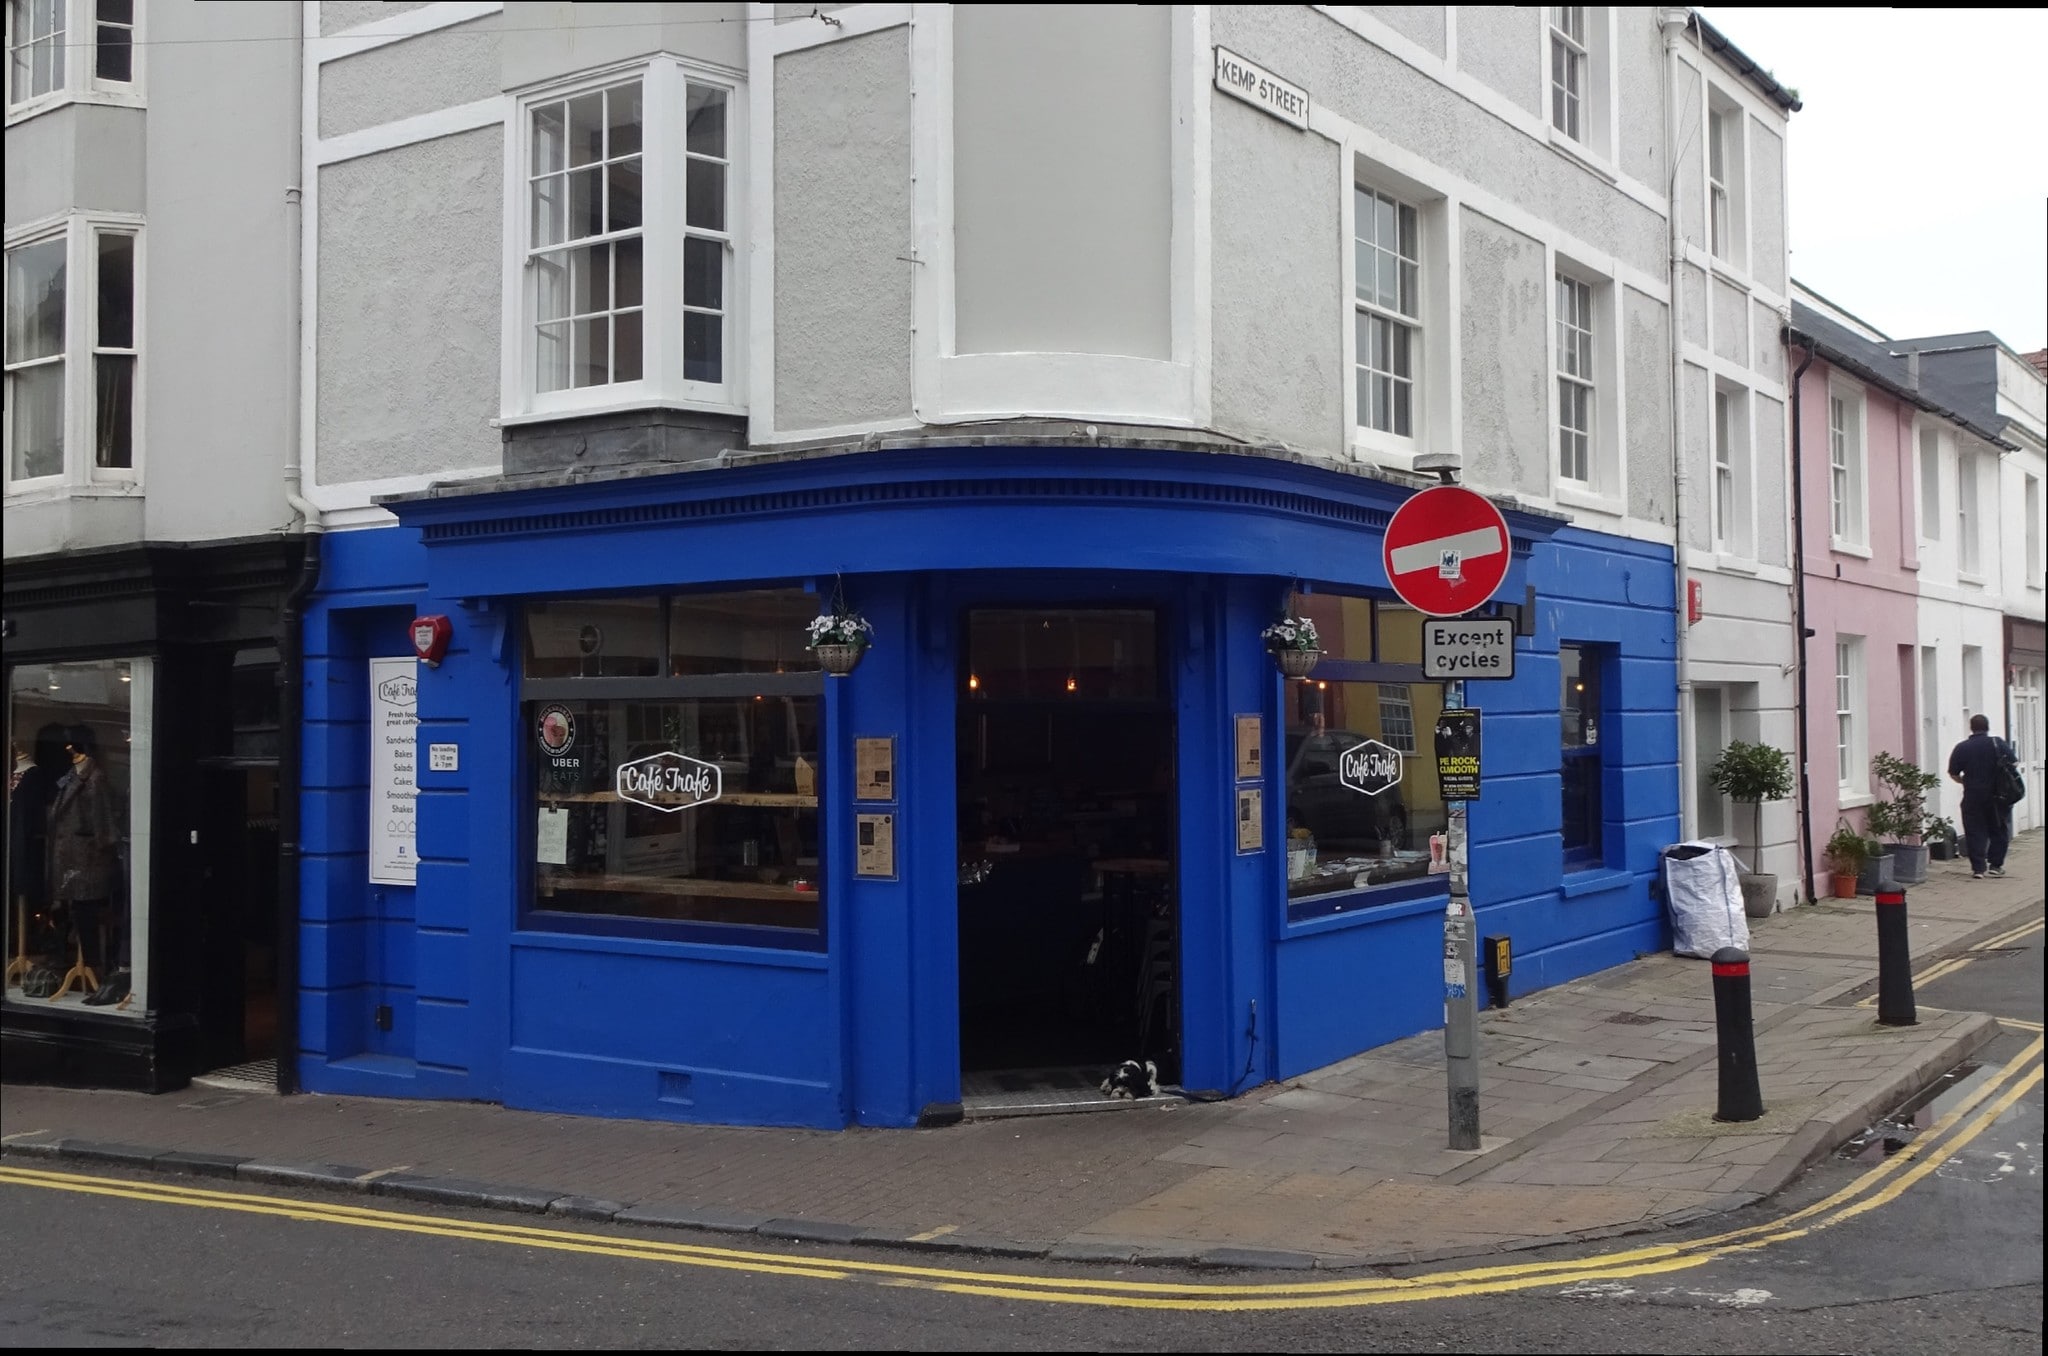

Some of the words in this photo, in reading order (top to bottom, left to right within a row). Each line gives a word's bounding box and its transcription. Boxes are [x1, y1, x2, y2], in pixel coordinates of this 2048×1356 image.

[1222, 58, 1256, 92] KEMP
[1259, 78, 1304, 118] STREET
[1433, 629, 1504, 648] Except
[1436, 651, 1501, 671] cycles
[383, 683, 400, 700] Café
[401, 683, 417, 697] Tra
[386, 719, 402, 727] great
[386, 735, 417, 744] Sandwich
[394, 749, 413, 758] Bakes
[439, 746, 456, 754] loading
[393, 763, 413, 772] Salads
[552, 758, 580, 768] UBER
[1345, 753, 1369, 785] Café
[1369, 751, 1397, 784] Trafé
[553, 771, 580, 781] EATS
[393, 777, 413, 785] Cakes
[626, 766, 664, 799] Café
[665, 766, 712, 800] Trafé
[386, 790, 417, 799] Smoothie
[391, 805, 414, 814] Shakes
